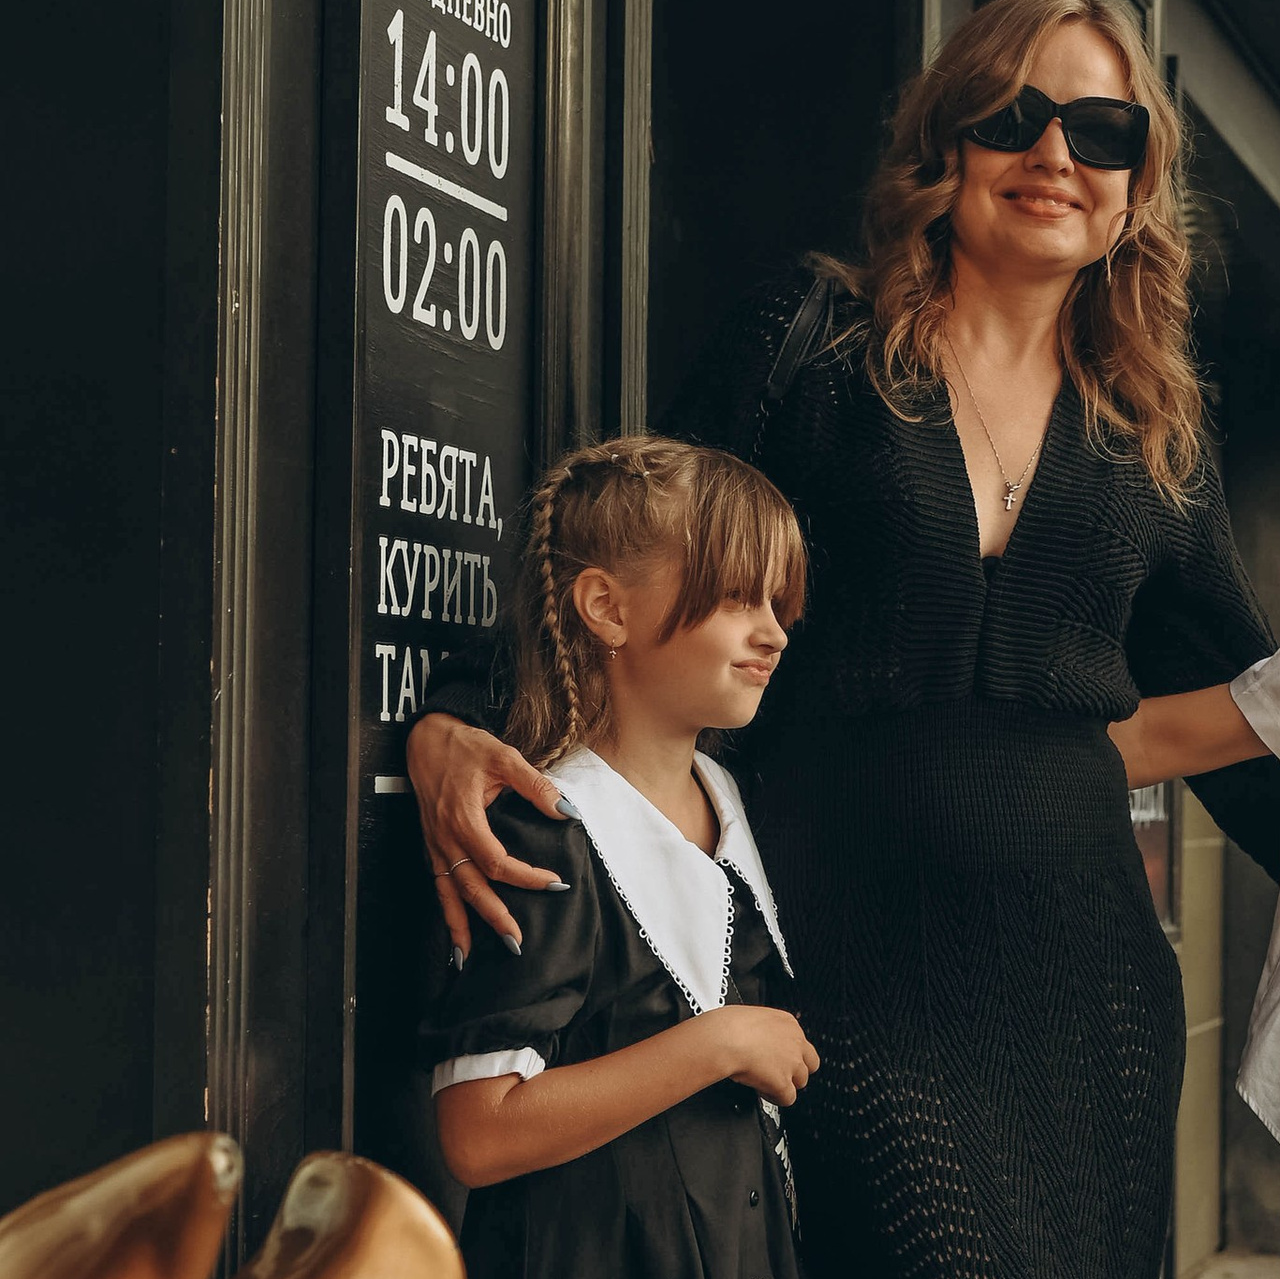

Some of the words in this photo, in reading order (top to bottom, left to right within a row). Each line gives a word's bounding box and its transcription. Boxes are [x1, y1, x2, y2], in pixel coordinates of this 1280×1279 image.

[385, 9, 510, 179] 14:00
[383, 194, 508, 351] 02:00
[379, 428, 503, 541] РЕБЯТА,
[376, 536, 498, 628] КУРИТЬ
[375, 643, 450, 722] ТА
